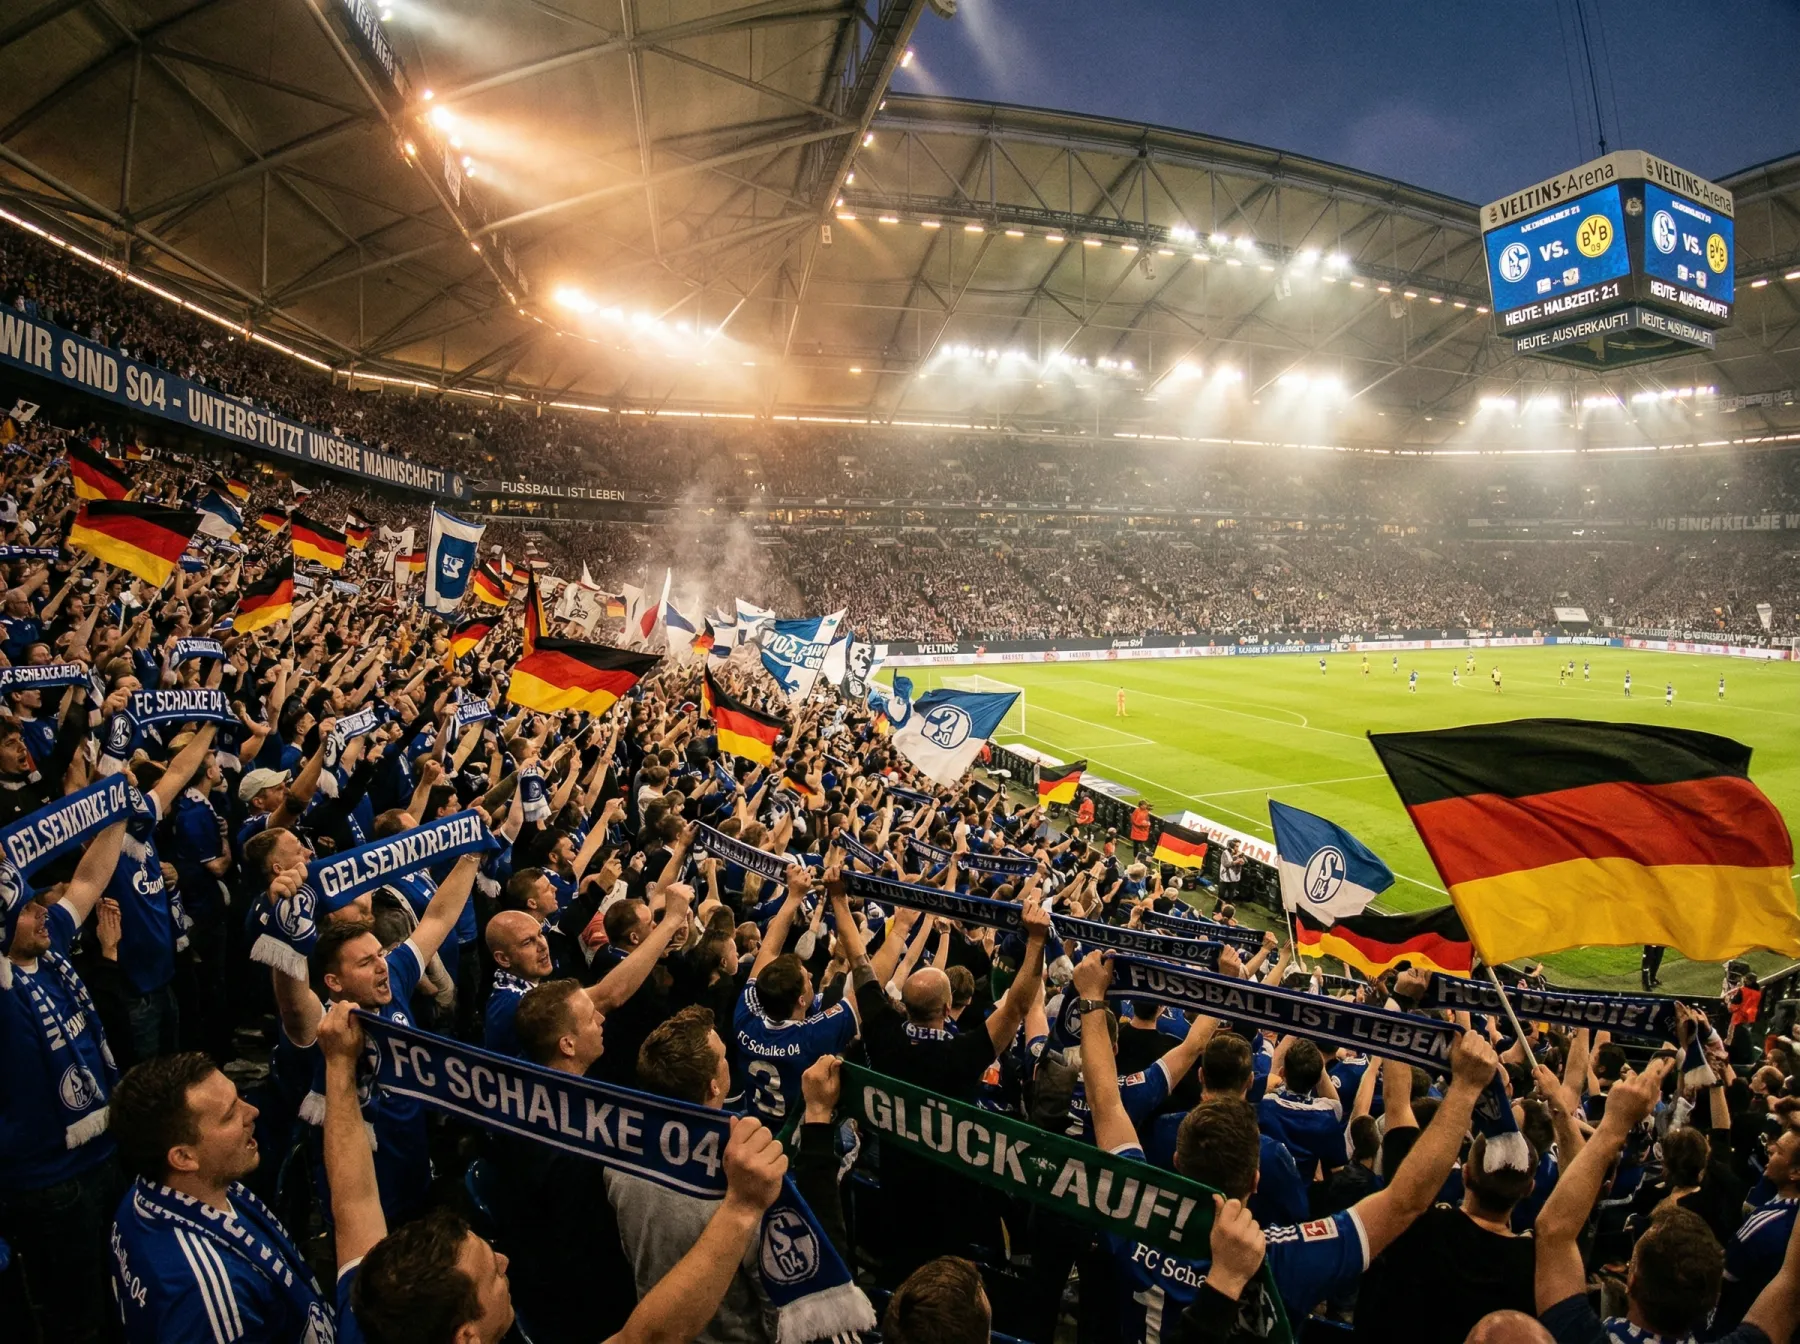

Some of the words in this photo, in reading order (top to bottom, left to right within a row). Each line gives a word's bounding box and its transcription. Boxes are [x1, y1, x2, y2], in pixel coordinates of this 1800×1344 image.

[1500, 163, 1614, 219] VELTINS-Arena
[1654, 160, 1732, 212] VELTINS-Arena
[1540, 240, 1569, 262] VS.
[1582, 219, 1608, 247] BVB
[1682, 233, 1702, 256] VS.
[1505, 305, 1542, 327] HEUTE:
[1543, 288, 1600, 316] HALBZEIT:
[1601, 283, 1620, 300] 2:1
[1517, 333, 1550, 352] HEUTE:
[1552, 312, 1629, 343] AUSVERKAUFT!
[0, 311, 53, 372] WIR
[61, 338, 119, 394] SIND
[126, 365, 166, 412] S04
[188, 388, 304, 455] UNTERSTÜTZT
[309, 432, 361, 472] UNSERE
[364, 451, 445, 493] MANNSCHAFT!
[501, 481, 564, 497] FUSSBALL
[567, 487, 586, 498] IST
[589, 488, 625, 501] LEBEN
[917, 643, 959, 654] VELTINS
[134, 692, 153, 717] FC
[156, 690, 208, 712] SCHALKE
[210, 691, 222, 712] 04
[7, 789, 109, 869] GELSENKIRKE
[109, 781, 127, 813] 04
[318, 815, 483, 898] GELSENKIRCHEN
[1129, 964, 1281, 1019] FUSSBALL
[1292, 1004, 1345, 1031] IST
[1352, 1017, 1453, 1062] LEBEN
[737, 1030, 750, 1046] FC
[747, 1039, 786, 1057] Schalke
[788, 1043, 801, 1056] 04
[388, 1037, 436, 1087] FC
[445, 1057, 644, 1155] SCHALKE
[659, 1121, 721, 1177] 04
[748, 1060, 786, 1117] 3
[862, 1085, 1031, 1185] GLÜCK
[1050, 1157, 1197, 1242] AUF!
[1131, 1242, 1160, 1269] FC
[130, 1276, 148, 1308] 04
